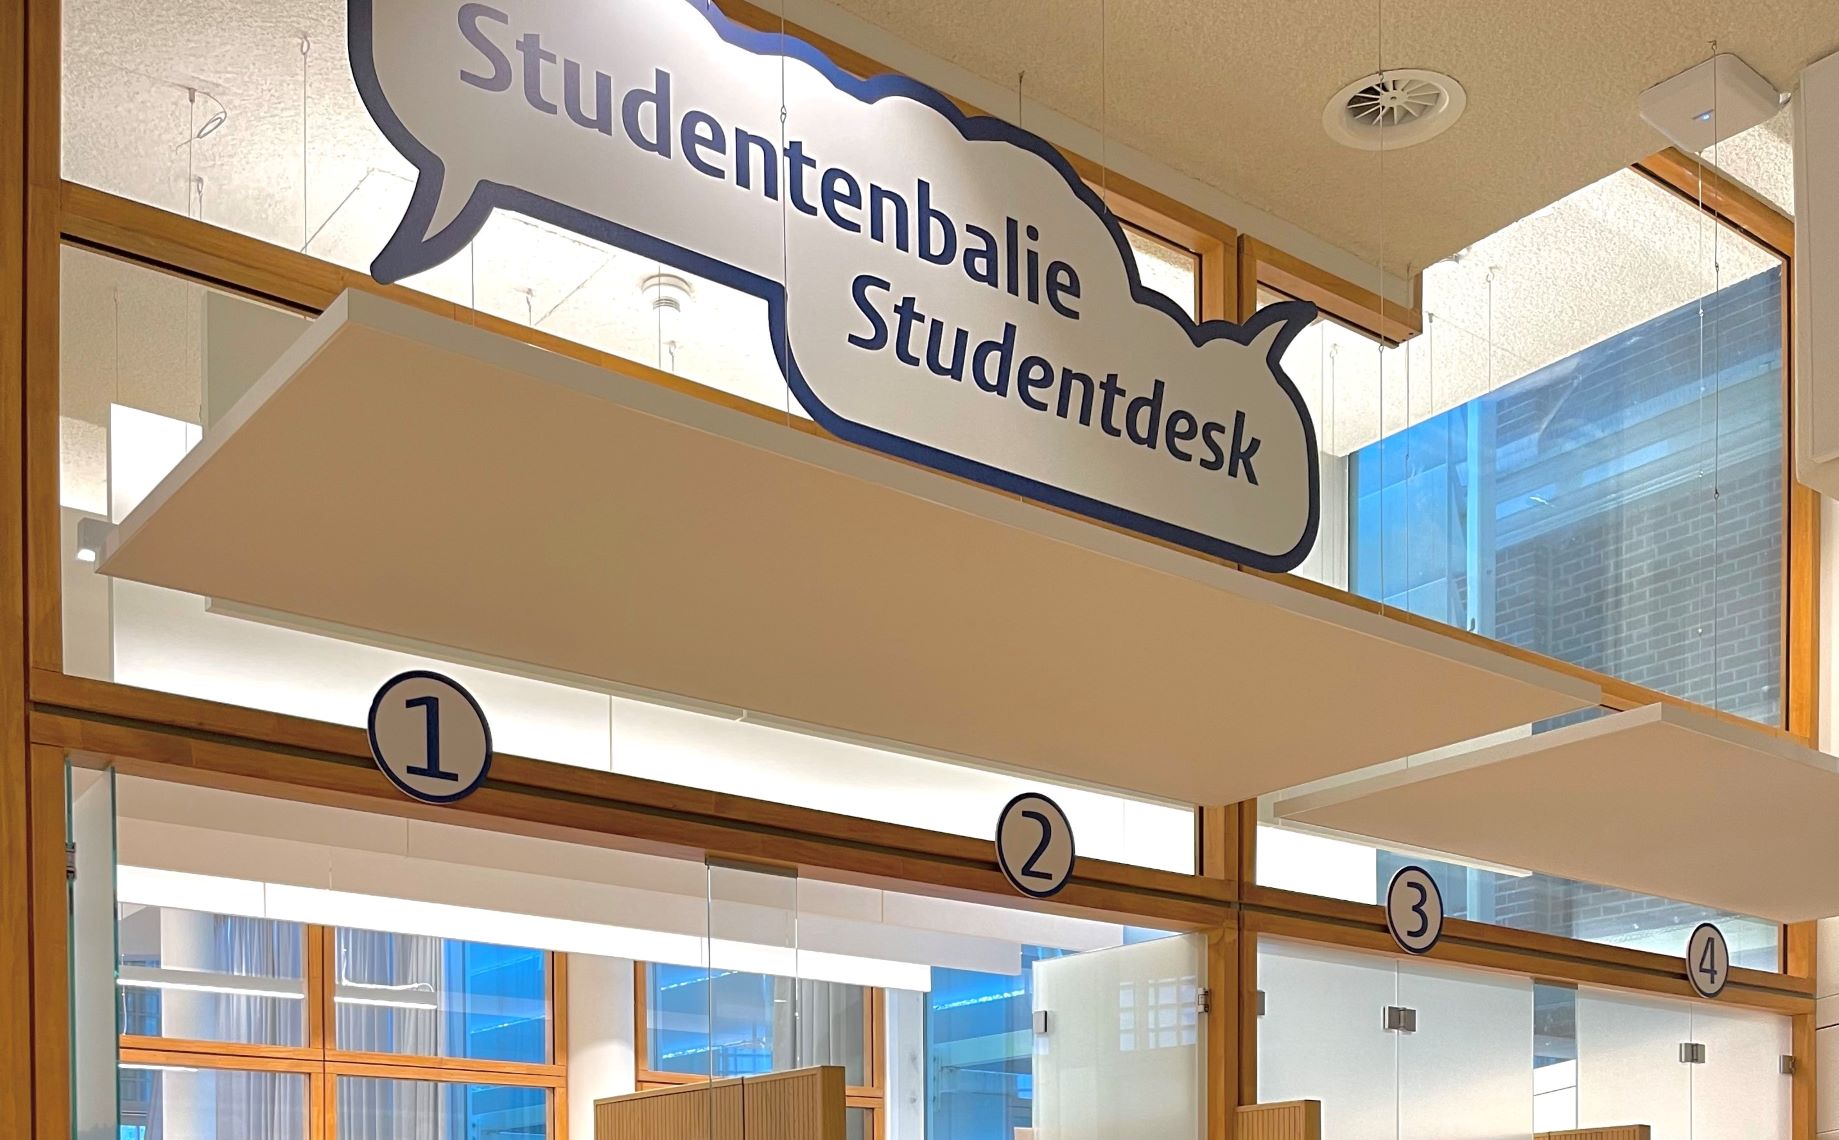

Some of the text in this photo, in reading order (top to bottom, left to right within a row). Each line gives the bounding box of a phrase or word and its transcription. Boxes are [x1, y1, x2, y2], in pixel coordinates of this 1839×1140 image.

[458, 2, 1082, 321] Studentenbalie
[847, 273, 1262, 486] Studentdesk
[405, 695, 459, 783] 1
[1020, 809, 1054, 881] 2
[1405, 880, 1429, 939] 3
[1698, 936, 1719, 985] 4
